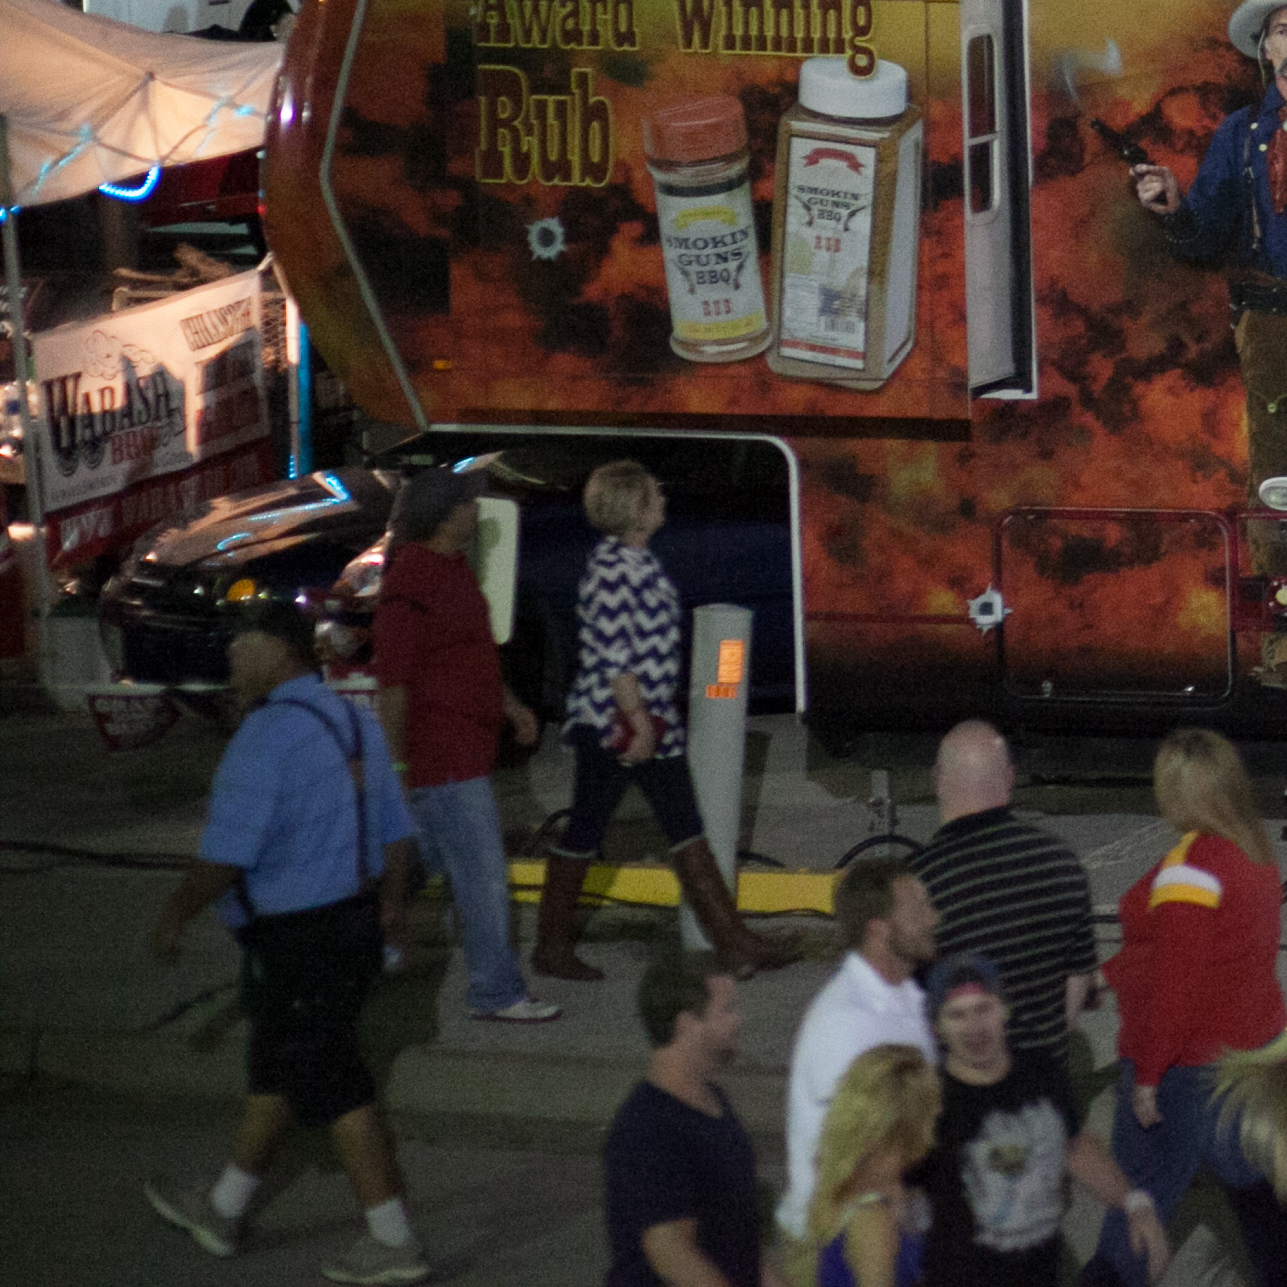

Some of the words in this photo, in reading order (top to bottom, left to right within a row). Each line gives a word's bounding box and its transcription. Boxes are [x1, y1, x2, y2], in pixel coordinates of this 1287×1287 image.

[474, 62, 616, 188] Rub
[677, 247, 743, 268] GUNS
[695, 268, 731, 286] BBQ
[43, 370, 173, 454] WABASH
